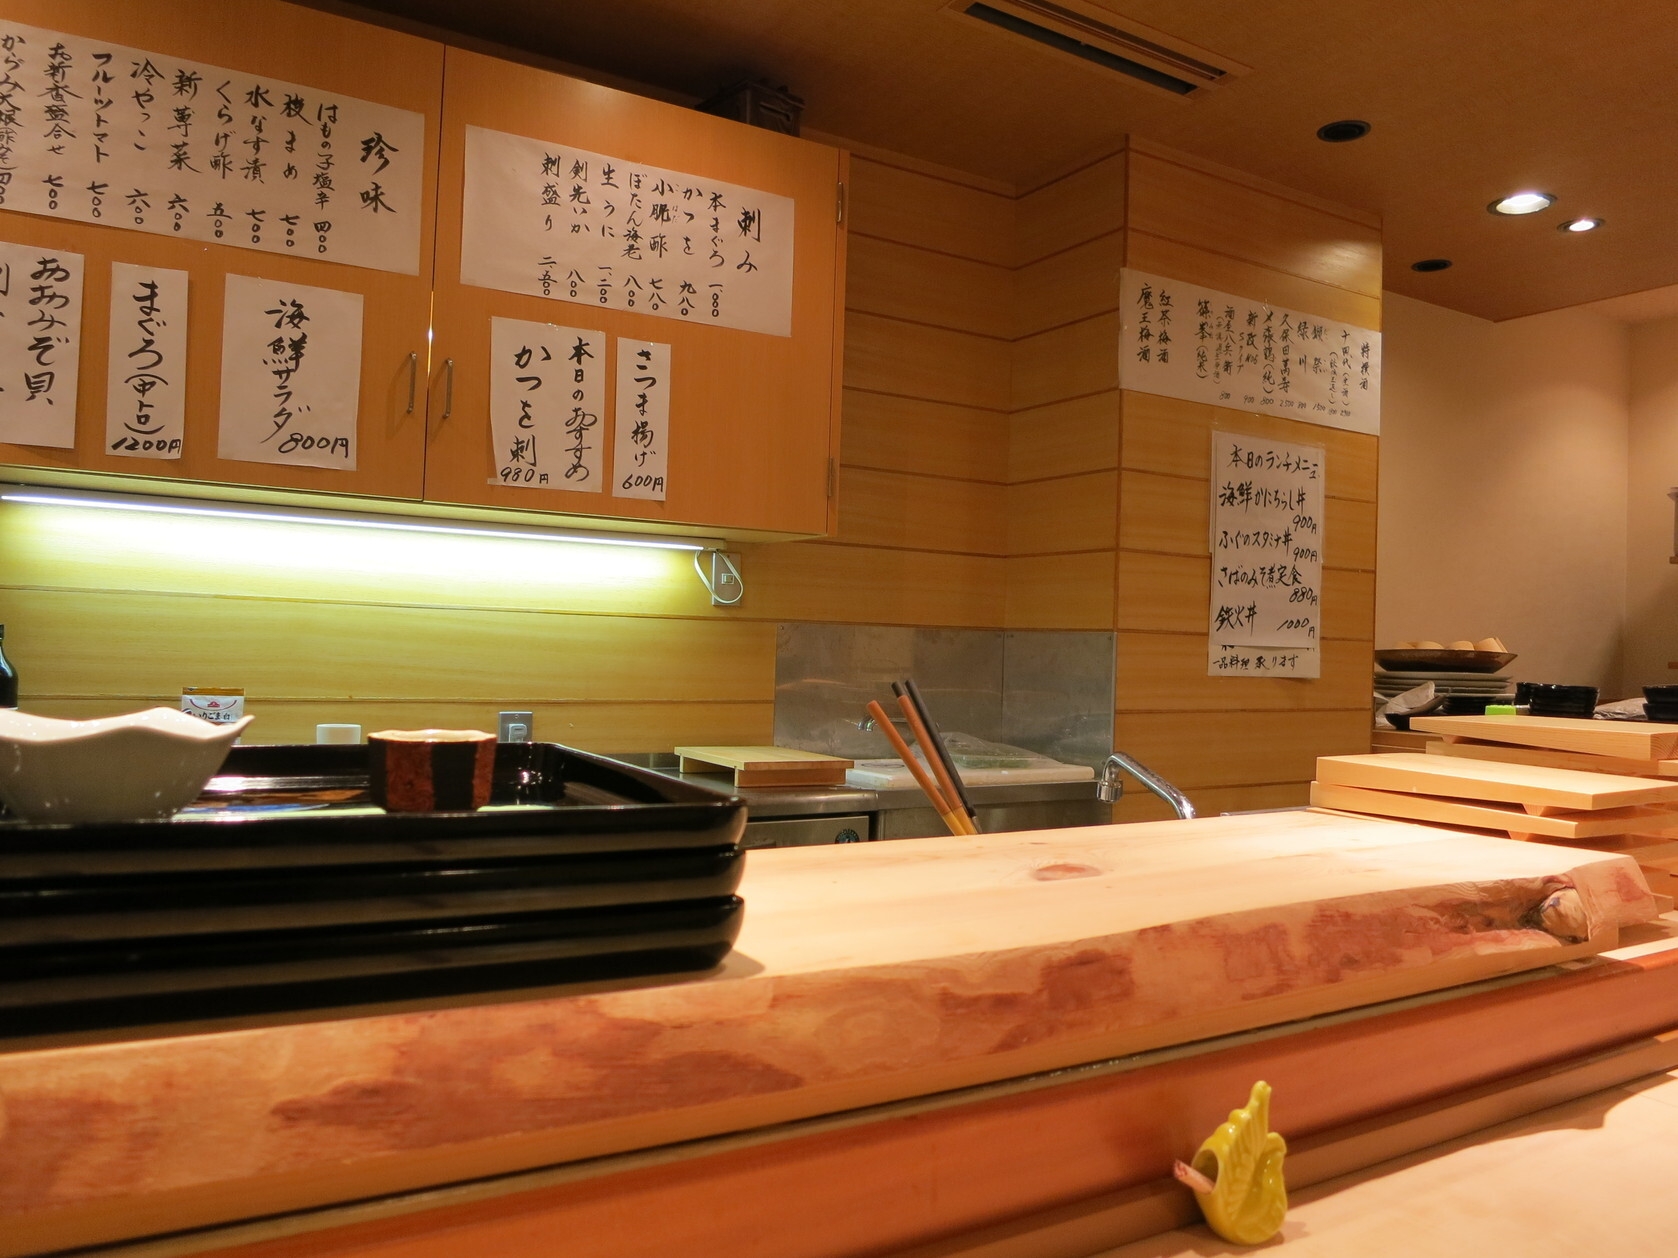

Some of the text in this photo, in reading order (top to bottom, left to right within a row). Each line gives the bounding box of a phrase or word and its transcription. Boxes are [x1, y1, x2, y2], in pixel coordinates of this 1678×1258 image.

[130, 58, 165, 152] 冷やっこ
[358, 132, 400, 214] 珍味
[601, 163, 620, 239] 生うに
[682, 186, 703, 256] かつを
[707, 192, 727, 268] 本まぐろ
[260, 298, 312, 444] 海鮮サラダ
[564, 336, 598, 482] 本日のおすすめ
[630, 349, 657, 467] さつま揚げ
[111, 437, 182, 455] 1200円
[278, 432, 350, 459] 800円
[500, 466, 549, 485] 980円
[622, 473, 664, 493] 600円
[1292, 514, 1317, 535] 900円
[1293, 547, 1318, 563] 900円
[1289, 587, 1318, 606] 880円
[1277, 620, 1316, 639] 1000円
